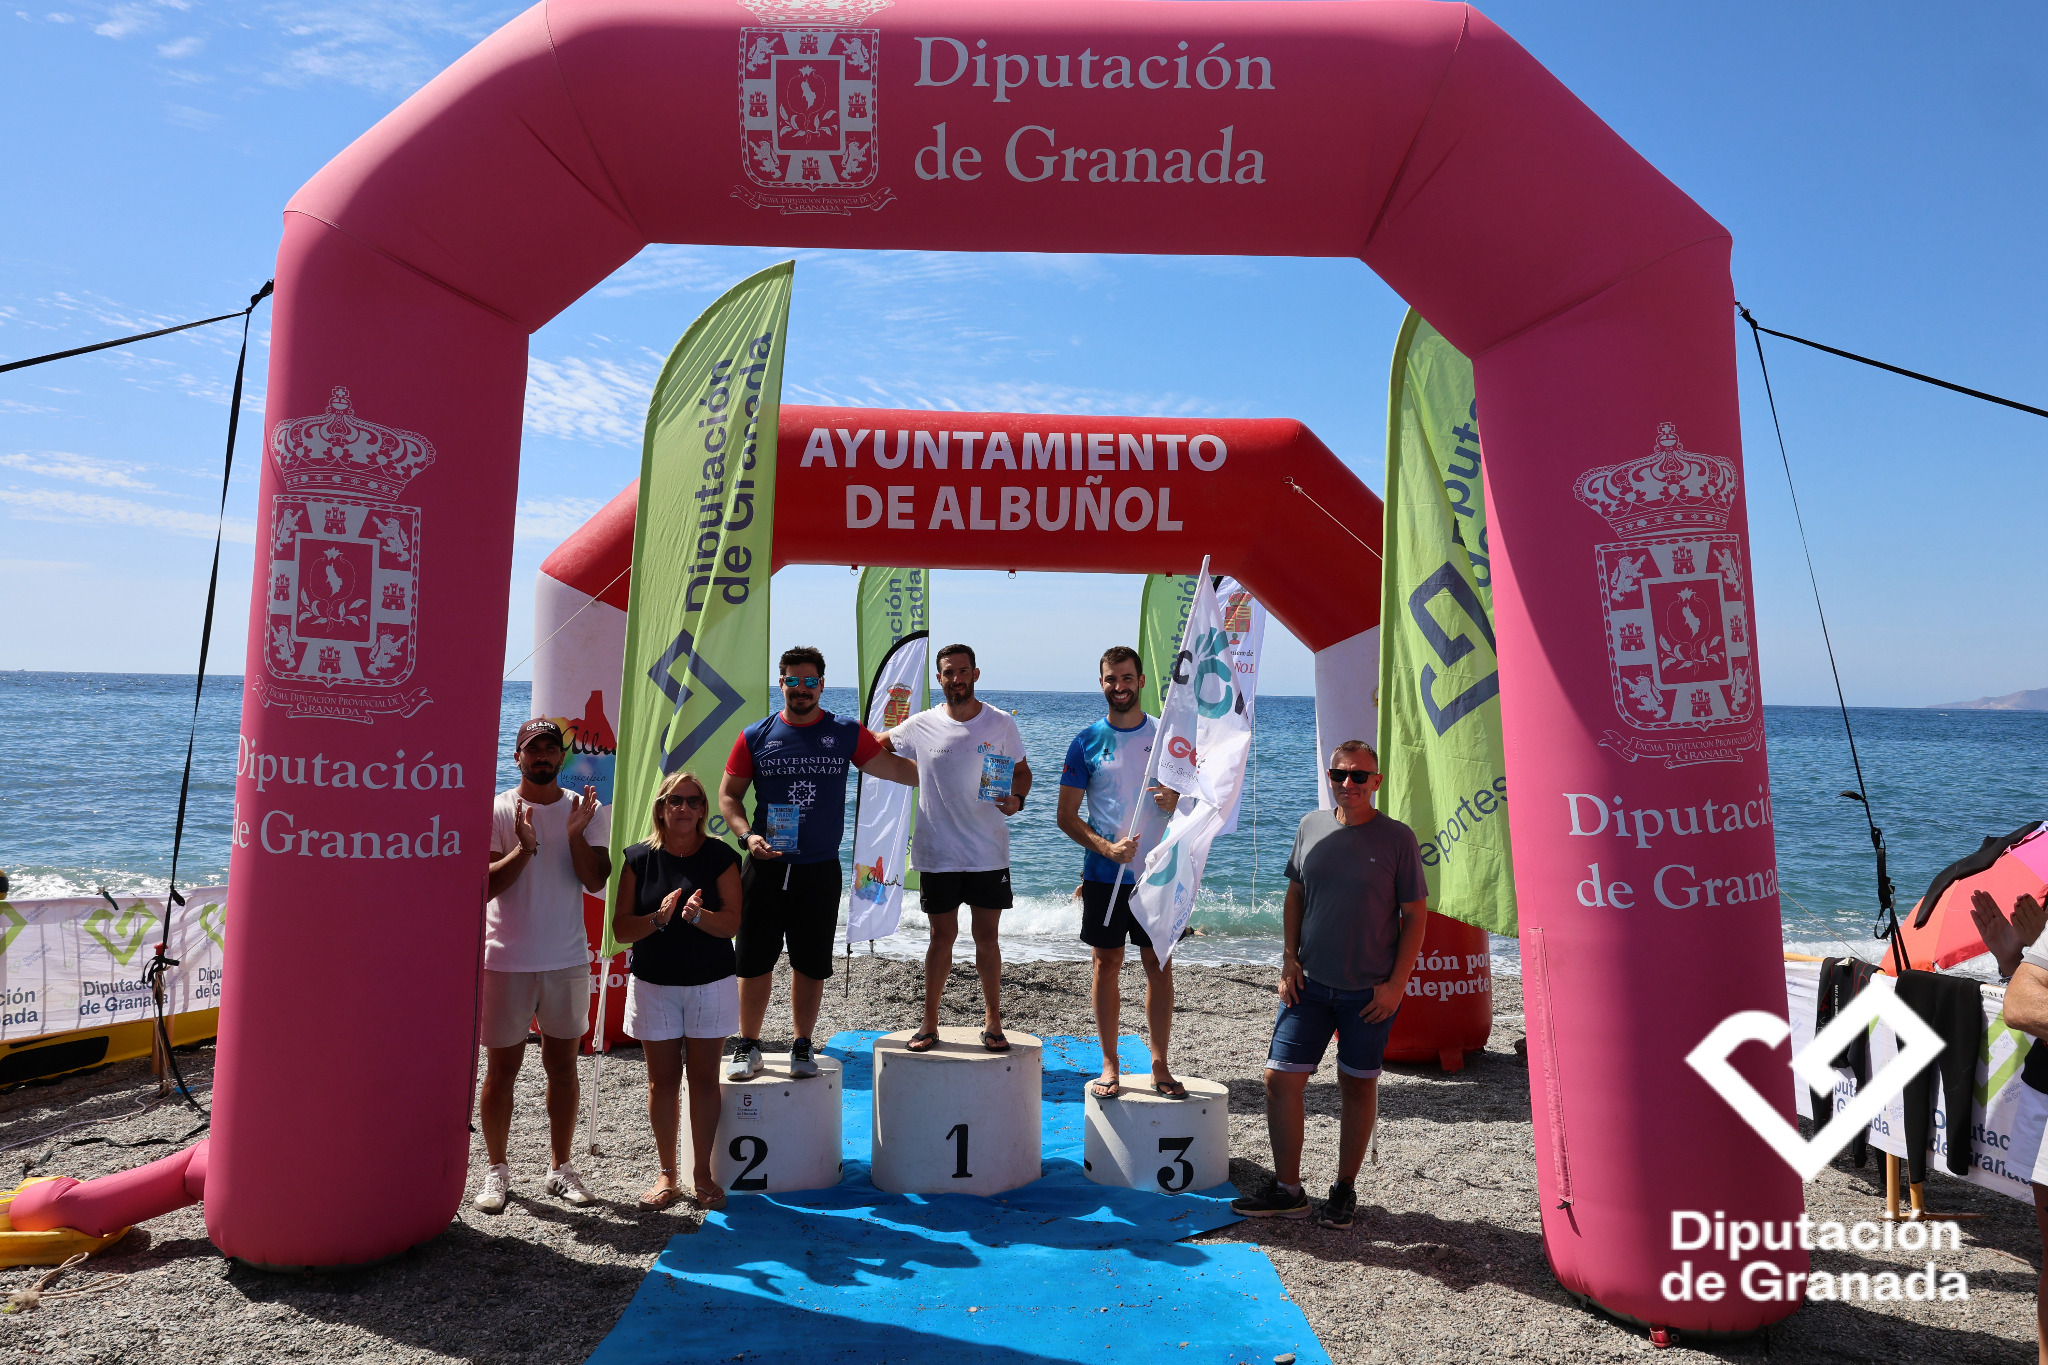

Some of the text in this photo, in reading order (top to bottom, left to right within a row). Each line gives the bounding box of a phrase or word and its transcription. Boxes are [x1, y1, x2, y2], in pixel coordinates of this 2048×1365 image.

[914, 36, 1275, 103] Diputación
[914, 122, 1266, 185] de Granada
[723, 332, 772, 605] de Granada
[800, 428, 1227, 471] AYUNTAMIENTO
[846, 475, 1183, 531] DE ALBUÑOL
[296, 702, 360, 716] GRANADA
[760, 756, 844, 768] UNIVERSIDAD
[762, 766, 841, 777] DE GRANADA
[1675, 749, 1734, 760] GRANADA
[232, 802, 461, 859] de Granada
[1577, 863, 1635, 909] de
[80, 993, 169, 1016] de Granaa
[1405, 974, 1490, 1001] deporte
[727, 1135, 768, 1191] 2
[945, 1123, 972, 1178] 1
[1156, 1136, 1194, 1192] 3
